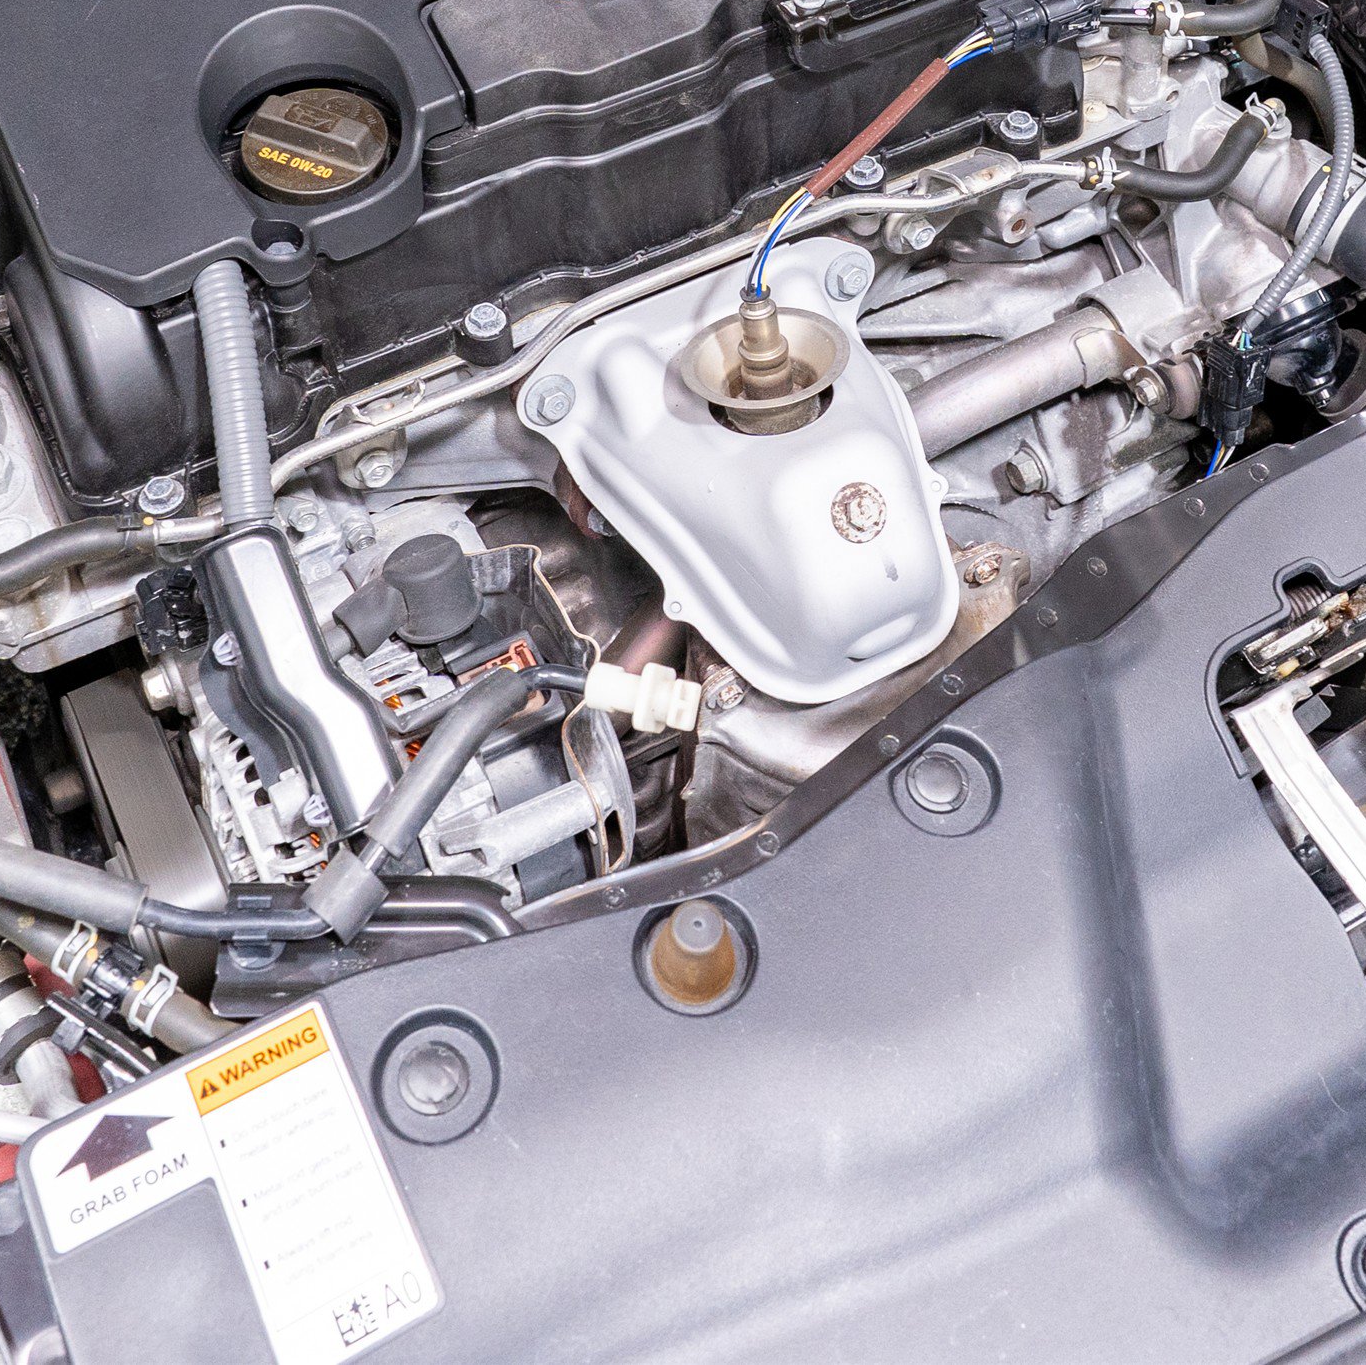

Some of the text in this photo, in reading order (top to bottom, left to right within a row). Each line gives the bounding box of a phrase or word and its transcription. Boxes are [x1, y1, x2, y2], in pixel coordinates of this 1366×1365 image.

[258, 147, 290, 164] SAE
[290, 157, 332, 178] 0W-20
[218, 1026, 318, 1087] WARNING
[250, 1117, 270, 1133] not
[270, 1100, 302, 1122] touch
[302, 1086, 328, 1105] bare
[332, 1143, 352, 1159] hot
[69, 1153, 188, 1225] GRAB FOAM
[260, 1204, 283, 1222] and
[333, 1214, 354, 1231] rod
